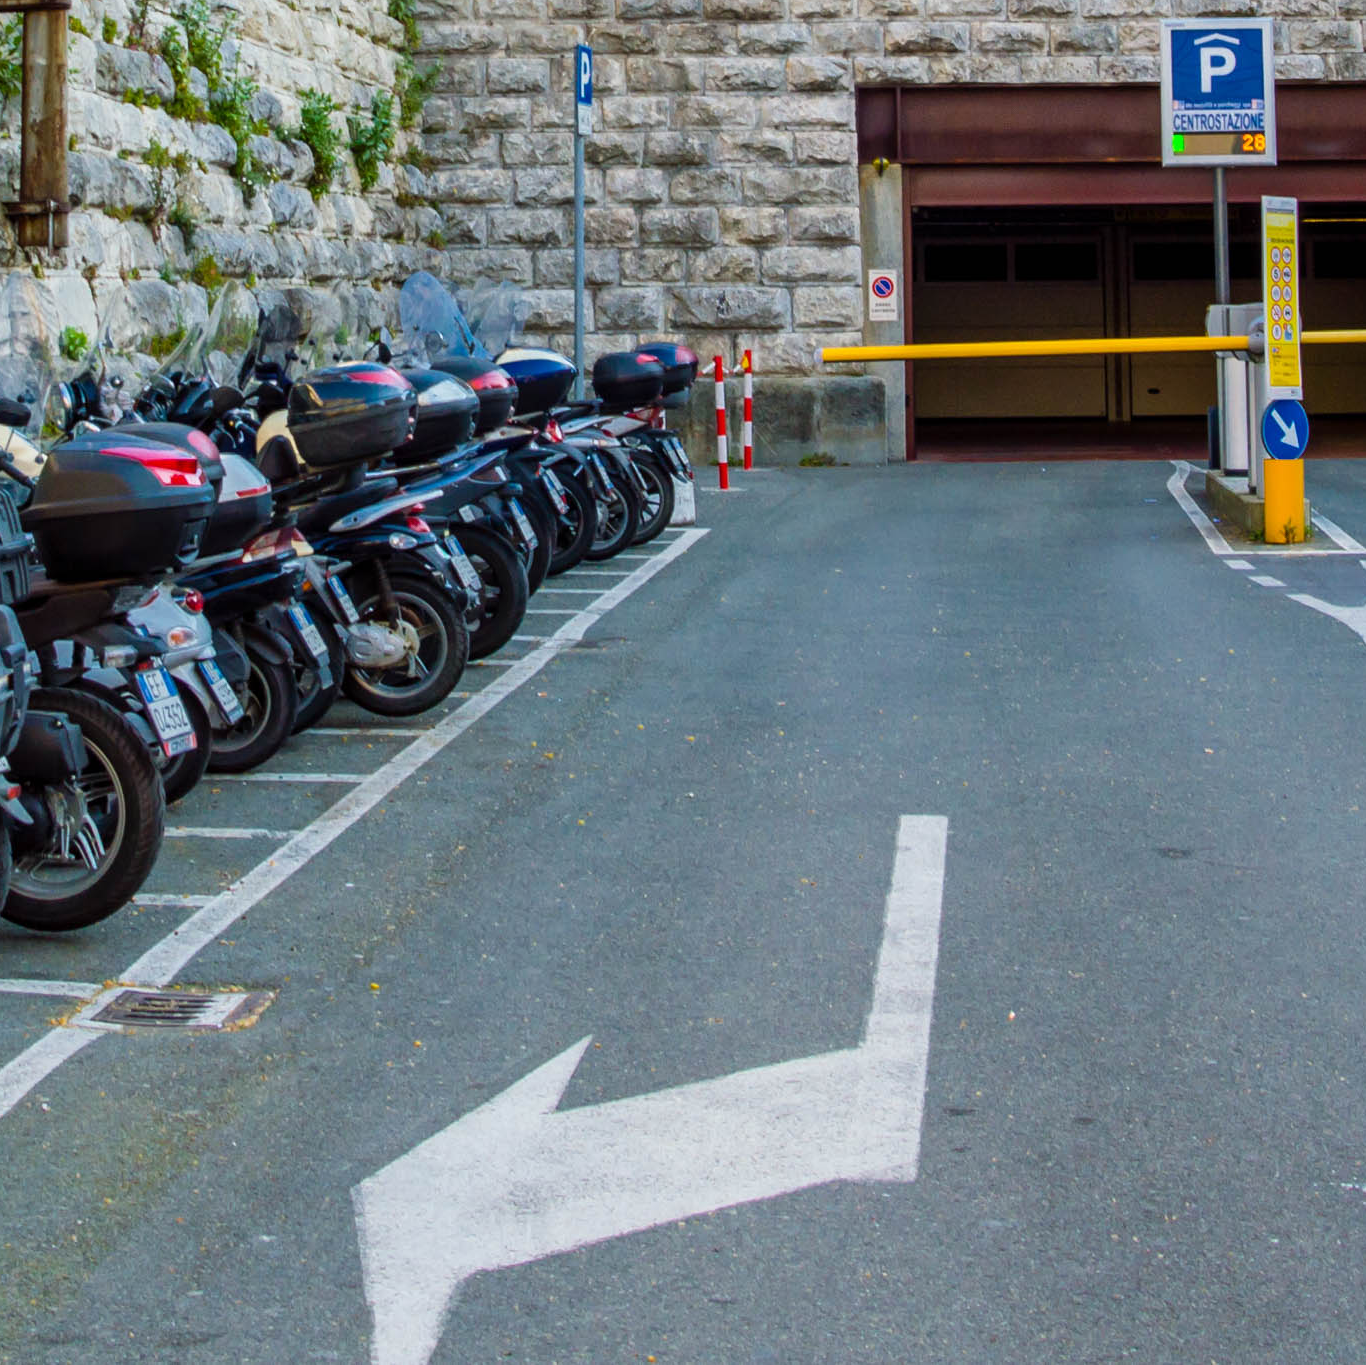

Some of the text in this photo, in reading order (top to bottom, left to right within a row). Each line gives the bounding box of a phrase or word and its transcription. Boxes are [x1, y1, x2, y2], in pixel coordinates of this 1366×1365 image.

[581, 52, 591, 98] P
[1200, 47, 1237, 93] P
[1173, 113, 1265, 131] CENTROSTAZIONE
[145, 673, 160, 699] EF
